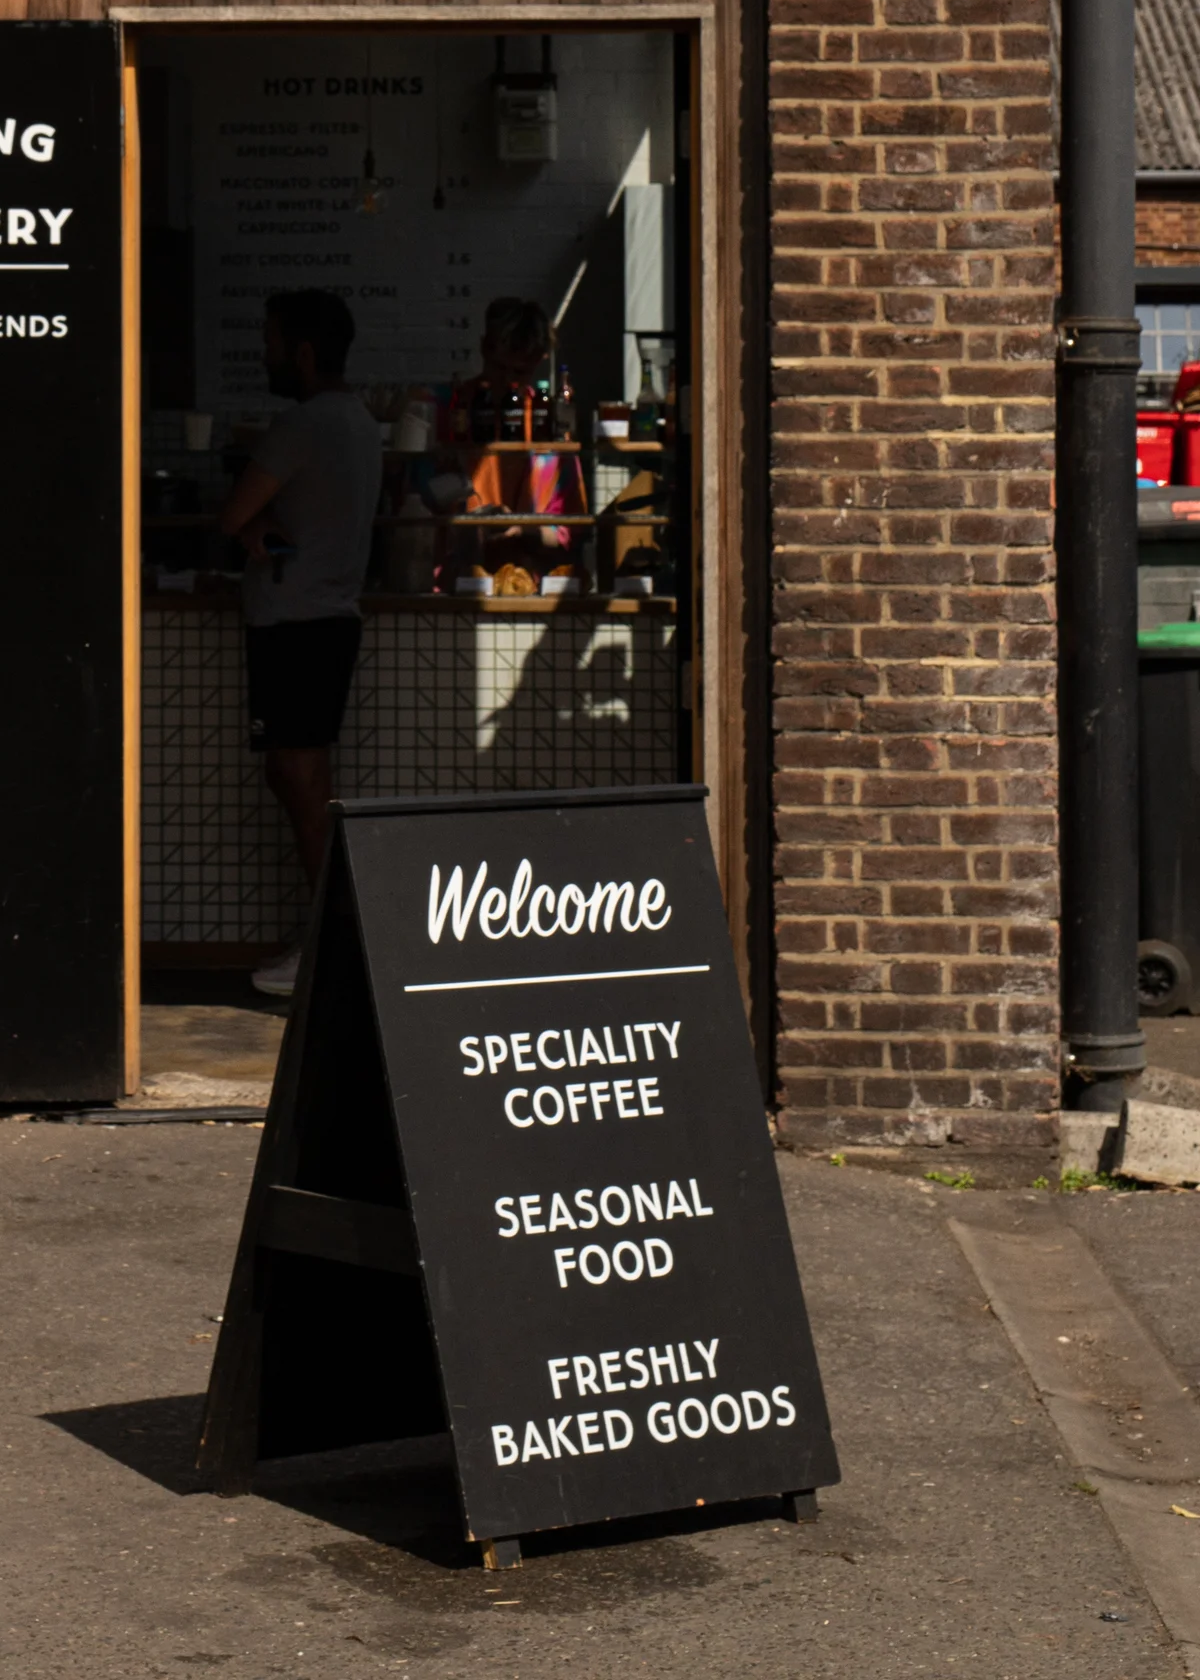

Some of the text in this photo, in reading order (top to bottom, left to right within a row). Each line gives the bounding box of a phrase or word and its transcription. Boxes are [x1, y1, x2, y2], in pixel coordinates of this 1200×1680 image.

[263, 76, 425, 97] HOT DRINKS
[428, 859, 671, 944] Welcome
[460, 1021, 680, 1079] SPECIALITY
[505, 1077, 663, 1127] COFFEE
[495, 1179, 713, 1241] SEASONAL
[554, 1238, 673, 1288] FOOD
[548, 1339, 719, 1399] FRESHLY
[492, 1386, 796, 1465] BAKED GOODS
